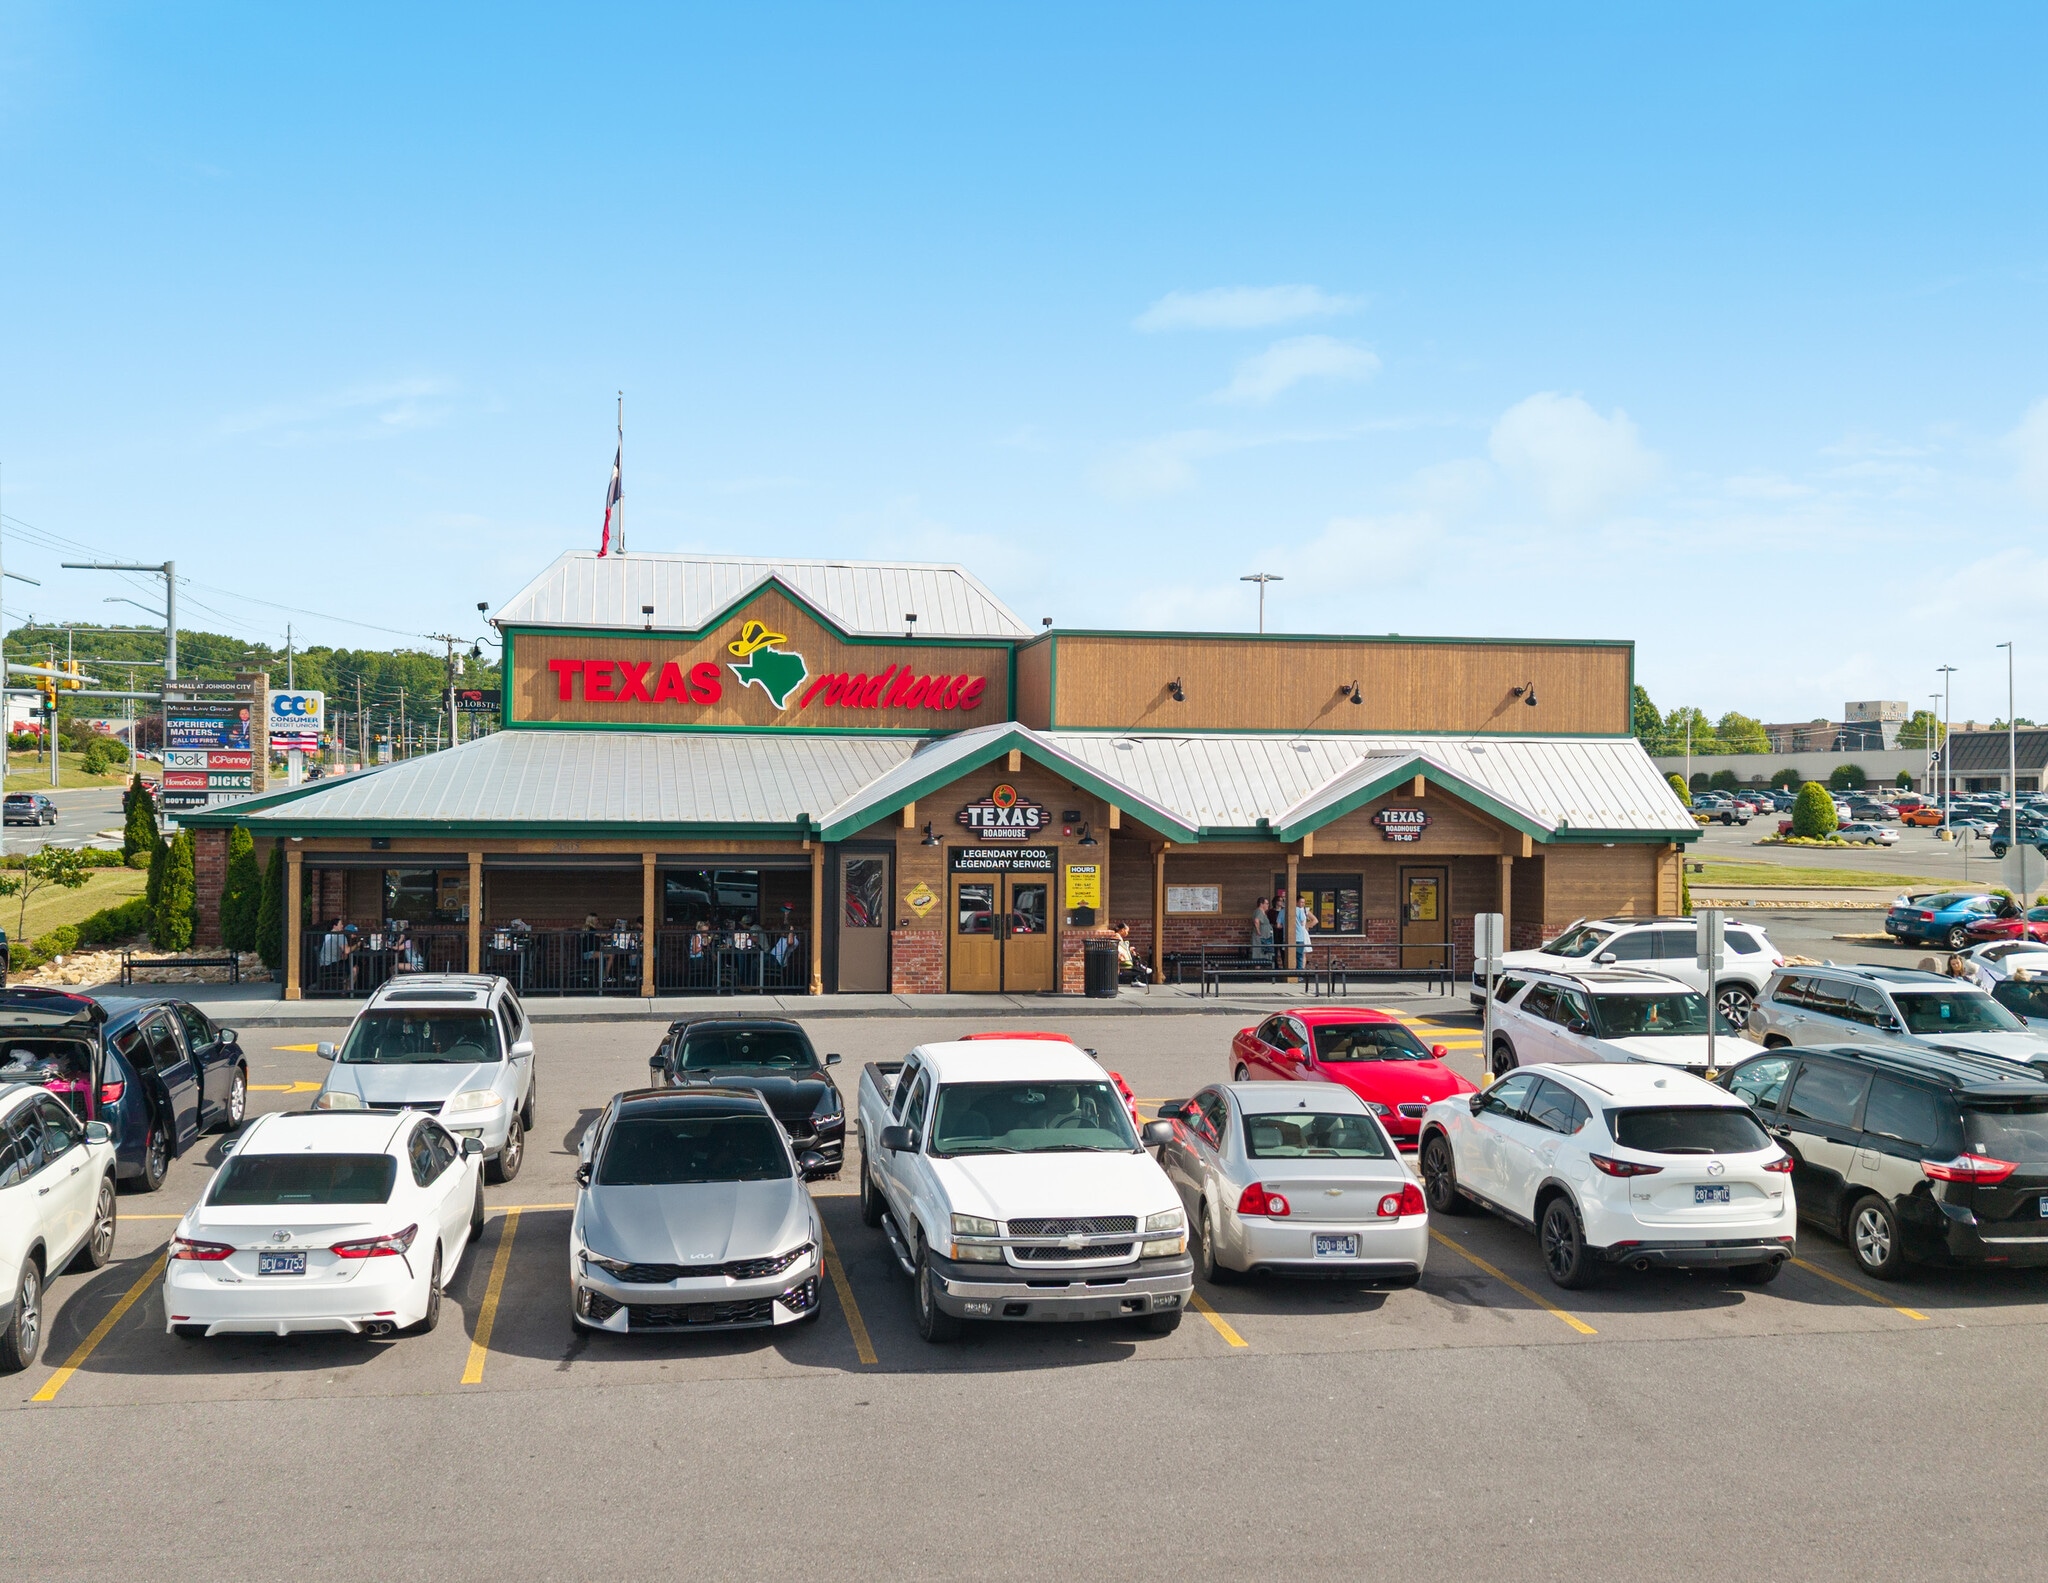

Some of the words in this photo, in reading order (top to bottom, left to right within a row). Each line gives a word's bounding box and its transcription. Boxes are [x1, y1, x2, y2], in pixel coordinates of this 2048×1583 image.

[548, 658, 722, 704] TEXAS
[800, 664, 987, 710] roadhouse
[271, 694, 319, 716] CCU
[167, 720, 224, 729] EXPERIENCE
[174, 753, 204, 766] belk
[209, 755, 251, 766] JCPenney
[1931, 751, 1939, 761] 3
[208, 775, 251, 787] DICK'S
[968, 807, 1039, 826] TEXAS
[1382, 811, 1424, 823] TEXAS
[983, 828, 1026, 838] ROADHOUSE
[963, 849, 1018, 858] LEGENDARY
[1020, 849, 1048, 859] FOOD,
[955, 860, 1011, 868] LEGENDARY
[1012, 860, 1051, 868] SERVICE
[1695, 1189, 1707, 1200] 287
[1712, 1189, 1729, 1200] BMTC
[1317, 1240, 1331, 1251] 500
[1336, 1240, 1354, 1251] BHLR
[261, 1258, 276, 1270] BCV
[285, 1258, 304, 1270] 7753
